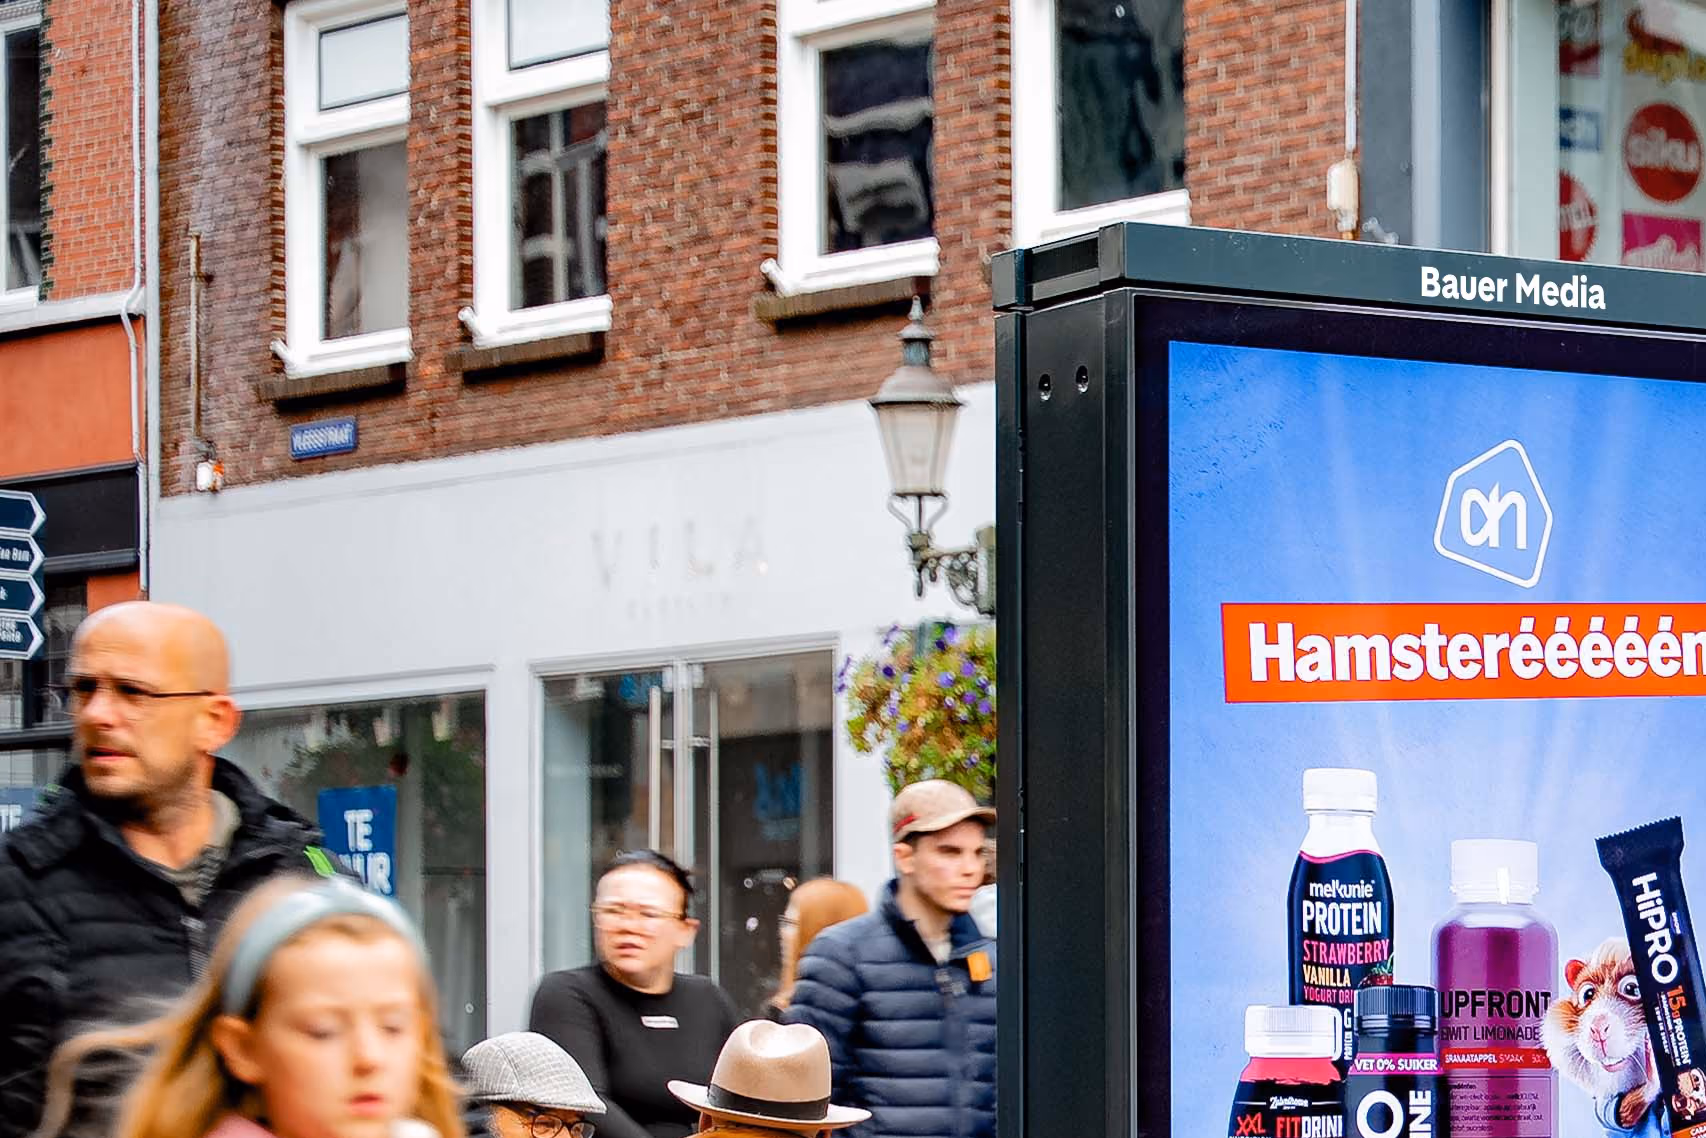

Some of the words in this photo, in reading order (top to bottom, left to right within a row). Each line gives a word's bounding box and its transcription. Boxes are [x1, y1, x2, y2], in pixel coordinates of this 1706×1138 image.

[1421, 266, 1508, 303] Bauer
[1515, 272, 1606, 310] Media
[344, 809, 373, 852] TE
[1309, 879, 1375, 898] melkunie
[1302, 900, 1382, 936] PROTEIN
[1632, 872, 1678, 985] HiPRO
[1303, 938, 1390, 965] STRAWBERRY
[1303, 964, 1351, 987] VANILLA
[1303, 985, 1337, 1003] YOGURT
[1440, 989, 1551, 1019] UPFRONT
[1473, 1026, 1540, 1041] LIMONADE
[1354, 1058, 1375, 1072] VET
[1376, 1058, 1395, 1072] 0%
[1397, 1058, 1438, 1072] SUIKER
[1236, 1111, 1267, 1137] XXL
